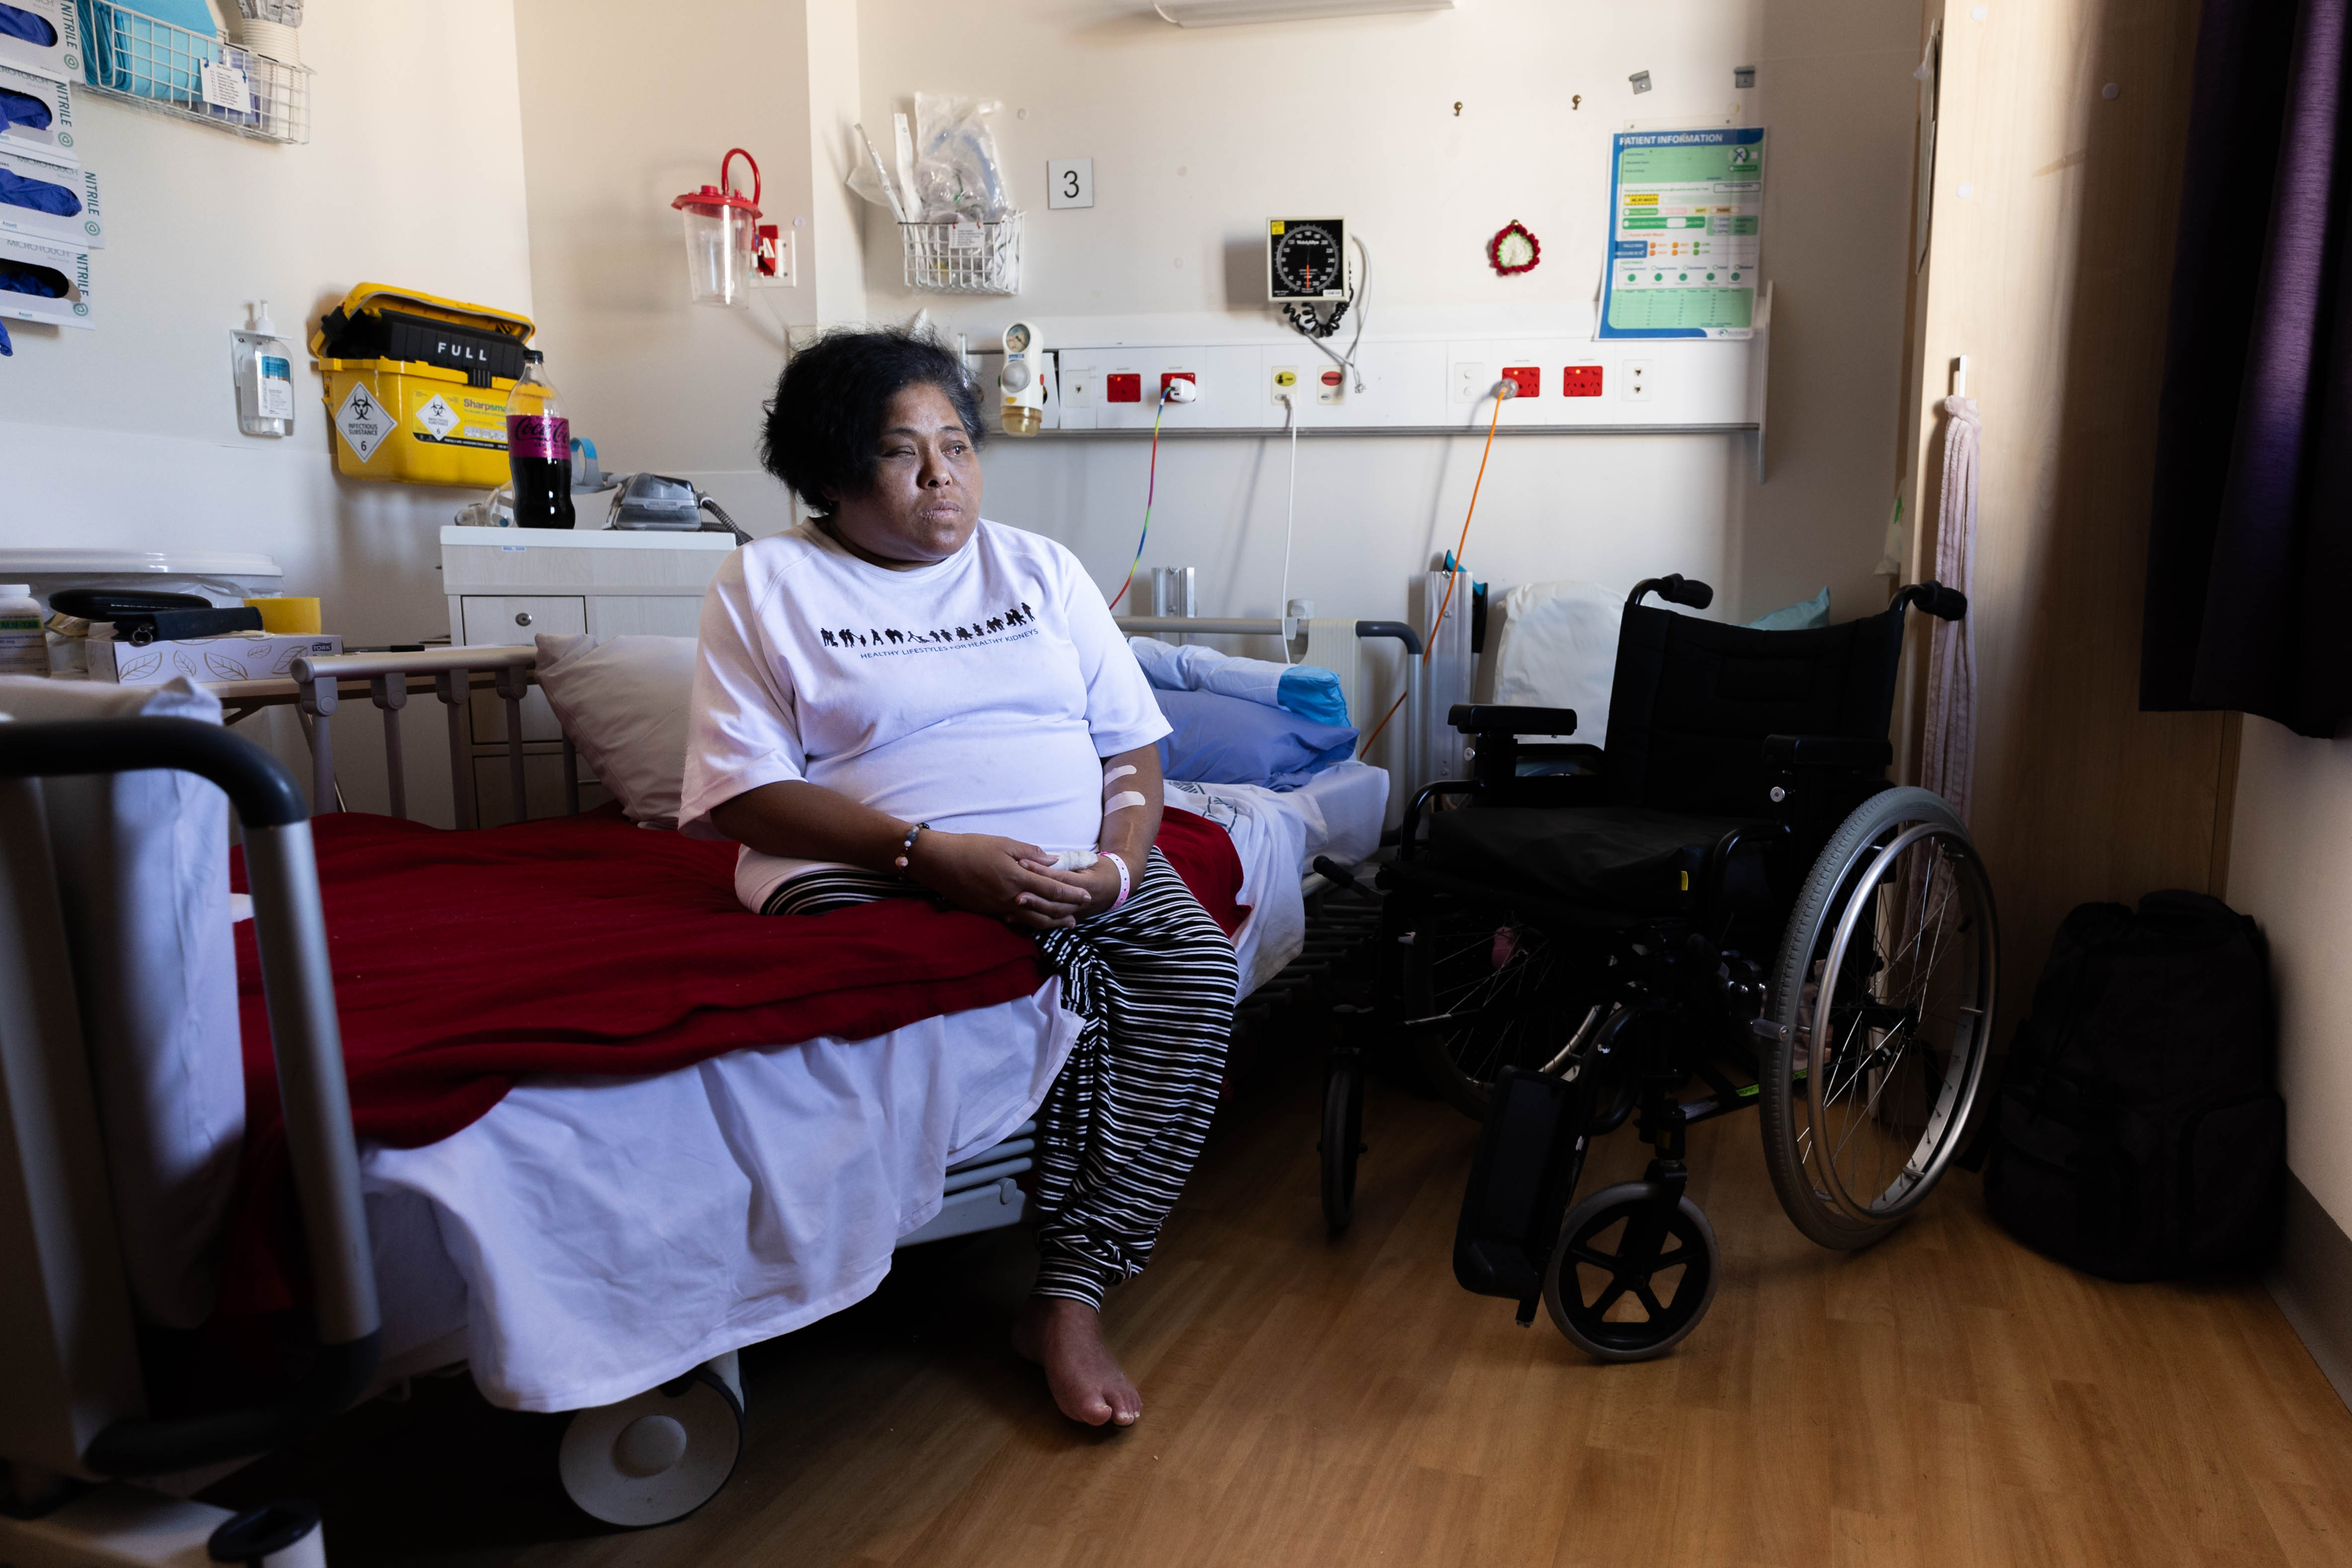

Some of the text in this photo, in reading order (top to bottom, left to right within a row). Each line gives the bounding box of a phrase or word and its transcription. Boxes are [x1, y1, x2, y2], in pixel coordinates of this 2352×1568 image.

[61, 3, 77, 50] NITRILE
[56, 81, 72, 127] NITRILE
[1619, 134, 1723, 146] PATIENT INFORMATION
[84, 171, 100, 216] NITRILE
[1063, 170, 1079, 198] 3
[76, 253, 89, 297] NITRILE
[438, 342, 487, 361] FULL
[361, 440, 367, 451] 6
[860, 650, 899, 659] HEALTHY
[902, 646, 948, 655] LIFESTYLES
[968, 638, 1002, 648] HEALTHY
[1005, 628, 1039, 642] KIDNEYS
